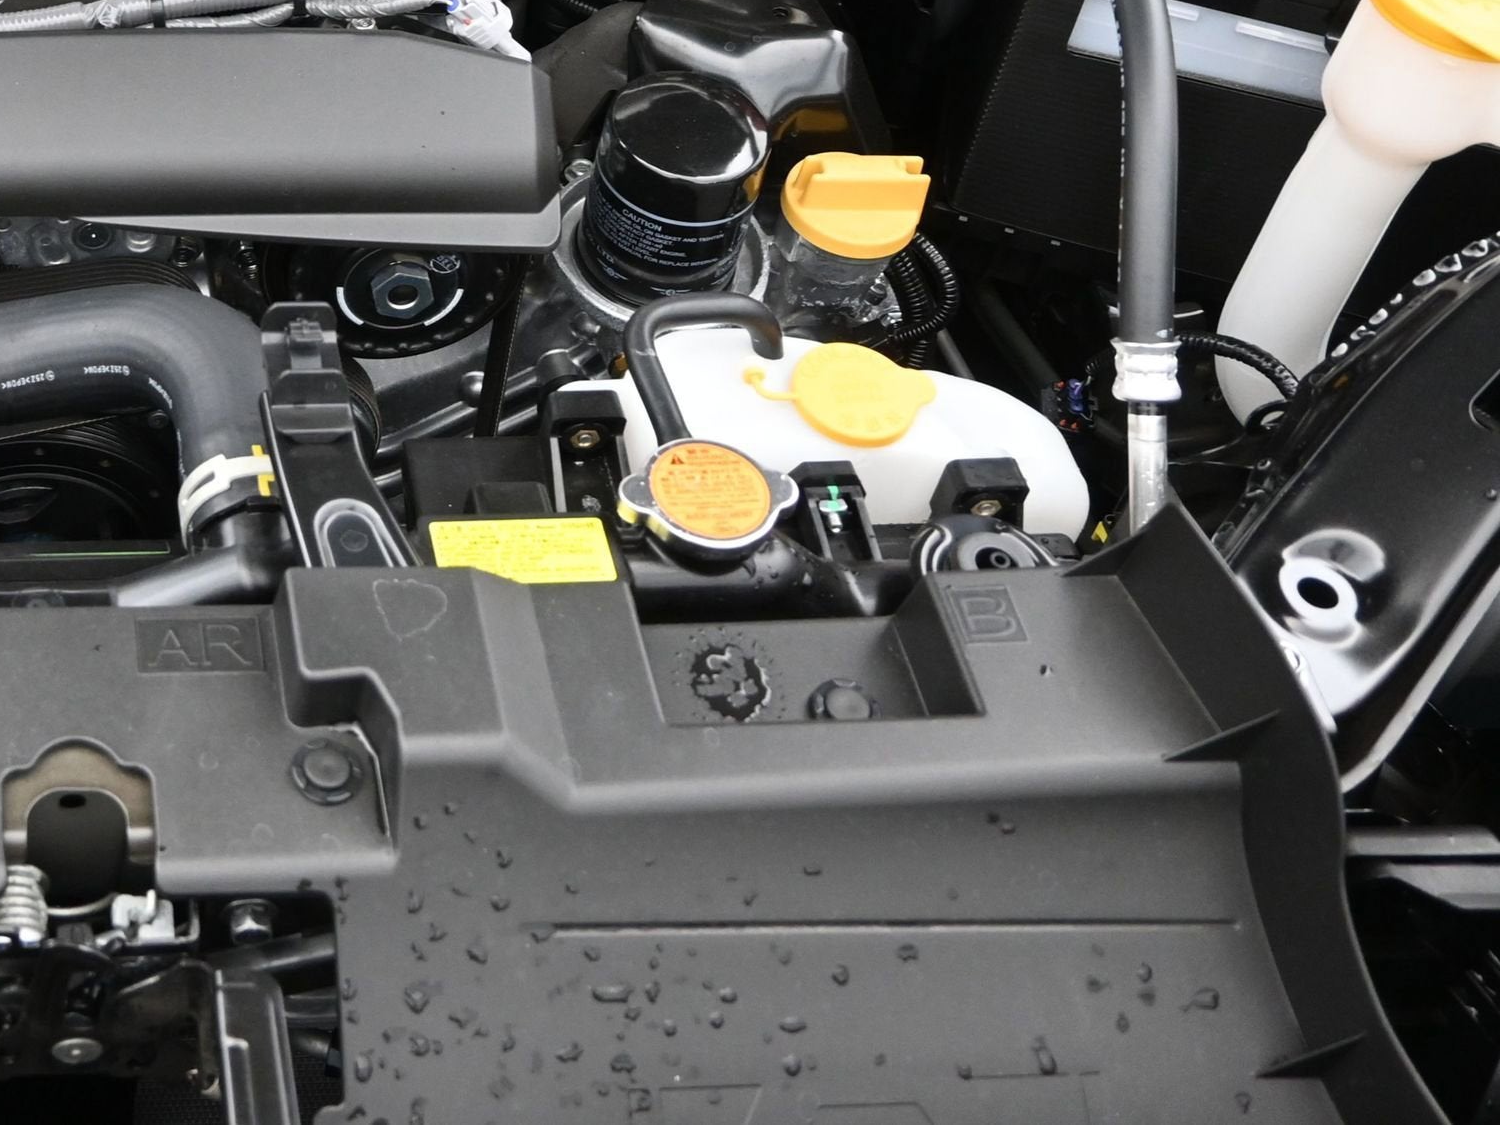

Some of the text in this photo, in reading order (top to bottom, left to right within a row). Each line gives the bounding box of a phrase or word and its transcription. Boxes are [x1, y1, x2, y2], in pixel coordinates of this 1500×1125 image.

[621, 208, 662, 232] CAUTION
[654, 231, 682, 242] GASKET
[643, 255, 658, 263] FOR
[147, 621, 253, 667] AR
